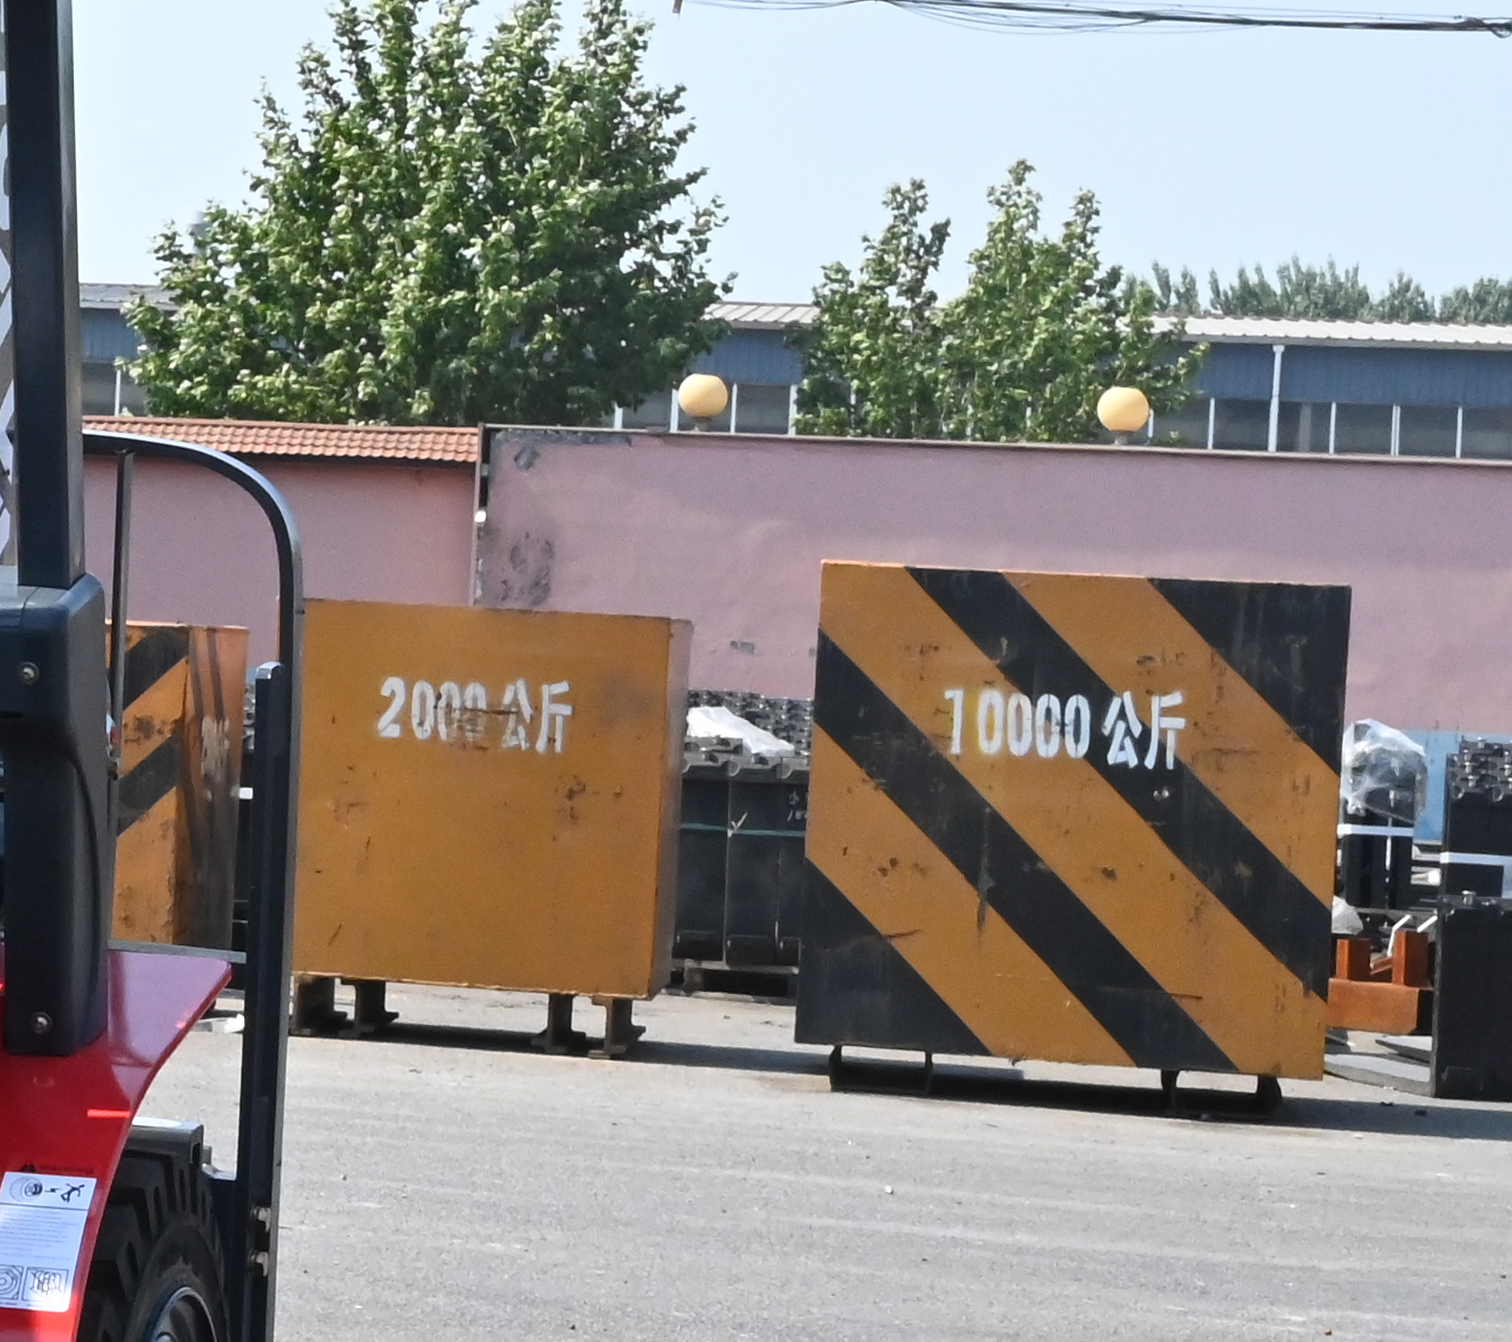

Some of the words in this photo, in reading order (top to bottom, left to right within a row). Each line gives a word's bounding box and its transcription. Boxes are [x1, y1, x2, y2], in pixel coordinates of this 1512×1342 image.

[377, 676, 487, 744] 2000
[500, 676, 573, 755] 公斤
[944, 689, 1092, 761] 10000
[1100, 689, 1188, 773] 公斤
